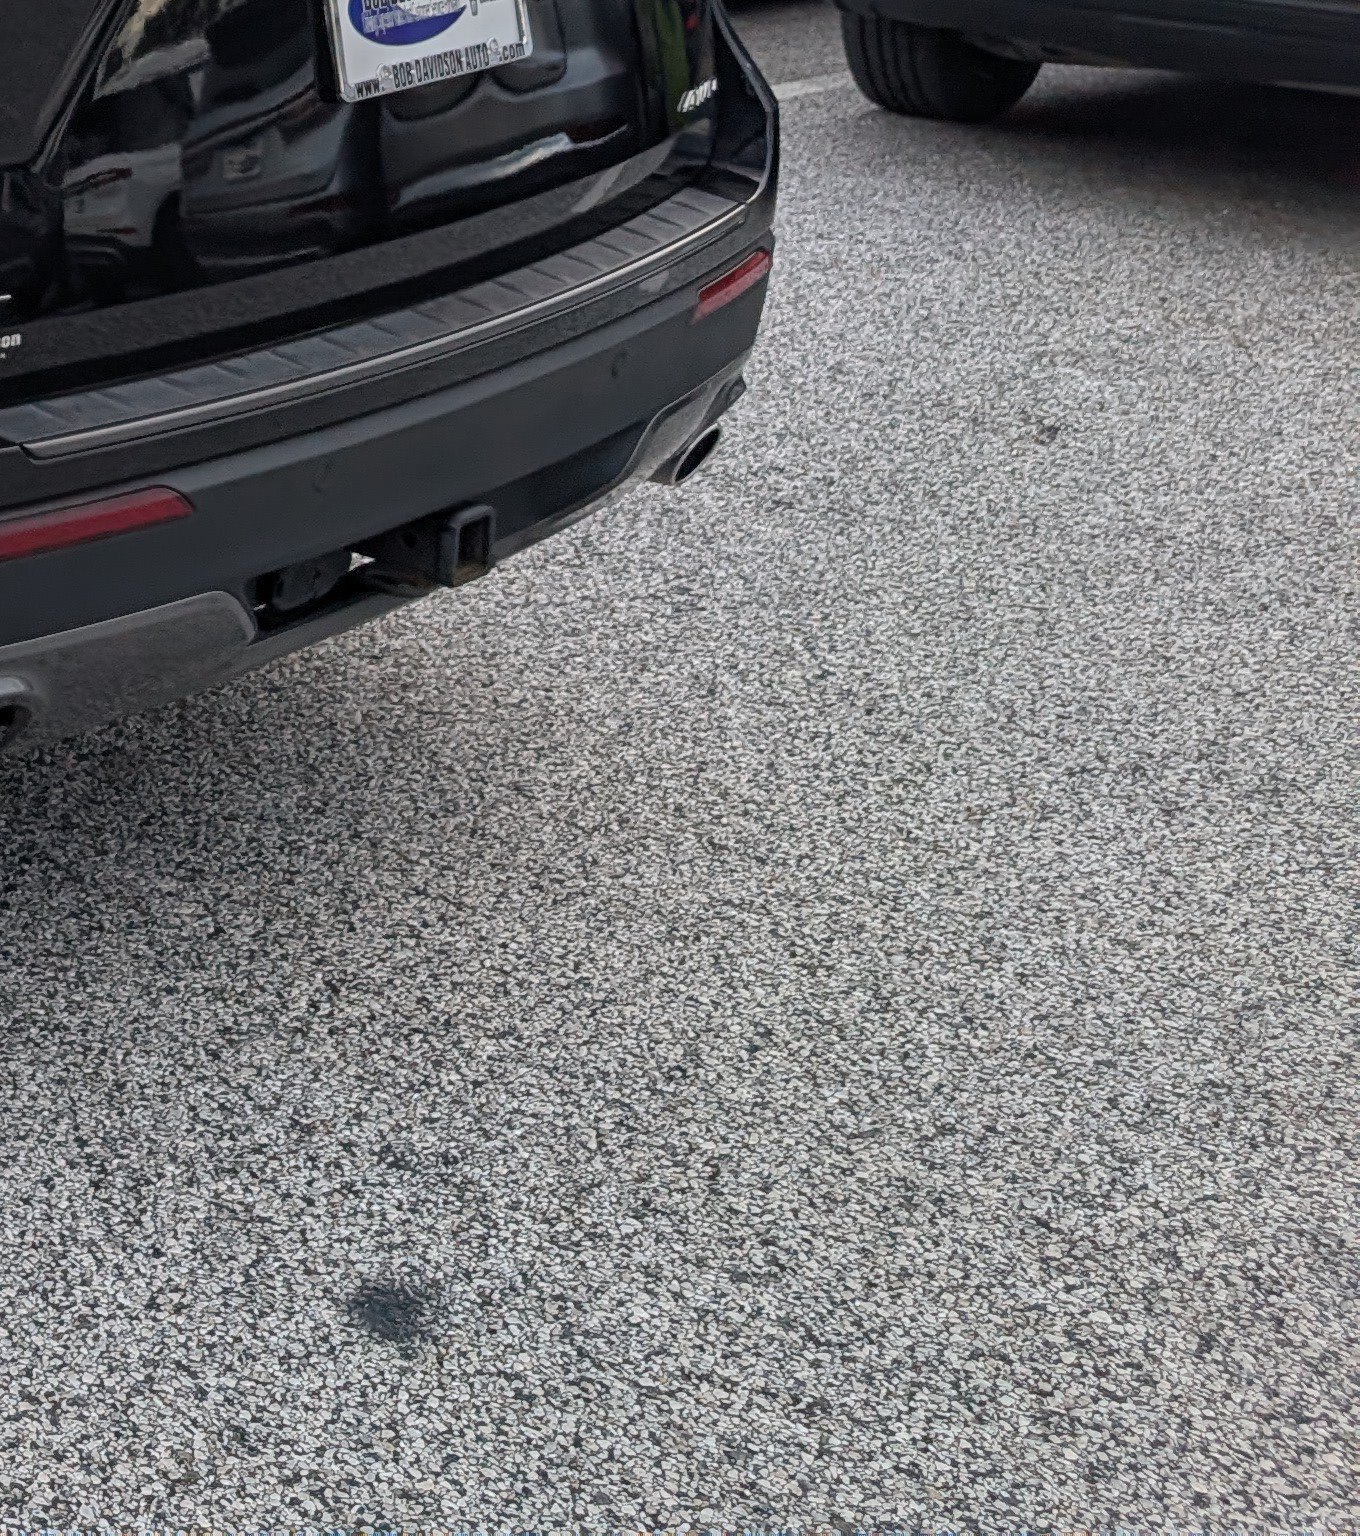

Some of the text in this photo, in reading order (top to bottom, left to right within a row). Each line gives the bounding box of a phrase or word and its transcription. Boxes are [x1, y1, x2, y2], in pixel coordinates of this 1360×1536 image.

[392, 62, 413, 89] BOB
[415, 49, 464, 83] DAVIDSON
[465, 43, 490, 71] AUTO
